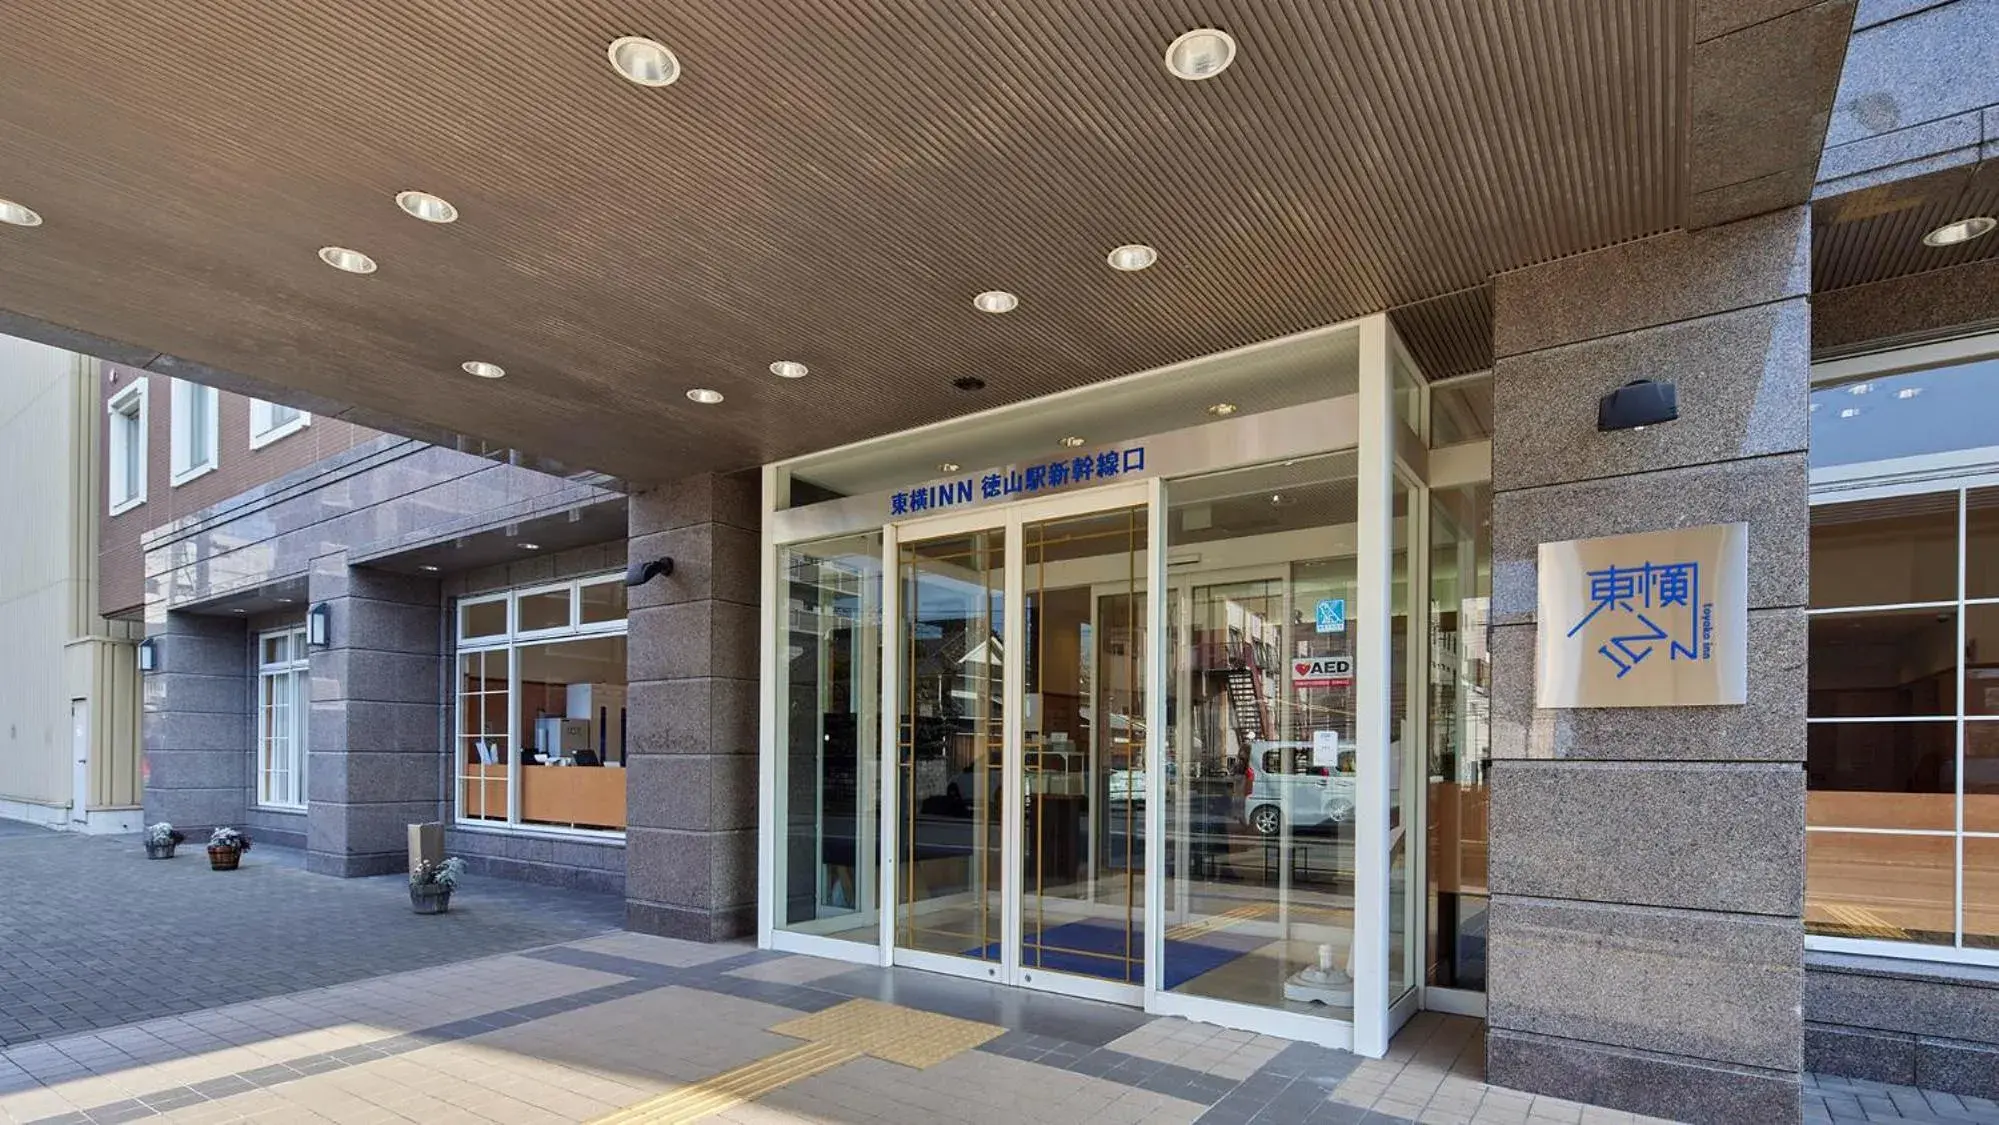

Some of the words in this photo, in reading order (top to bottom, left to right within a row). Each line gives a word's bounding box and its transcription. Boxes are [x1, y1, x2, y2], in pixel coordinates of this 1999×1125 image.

[890, 479, 973, 516] 東横INN
[981, 446, 1145, 500] 徳山駅新幹線口
[1702, 602, 1713, 640] toyoko
[1702, 641, 1713, 660] inn
[1310, 661, 1350, 674] AED
